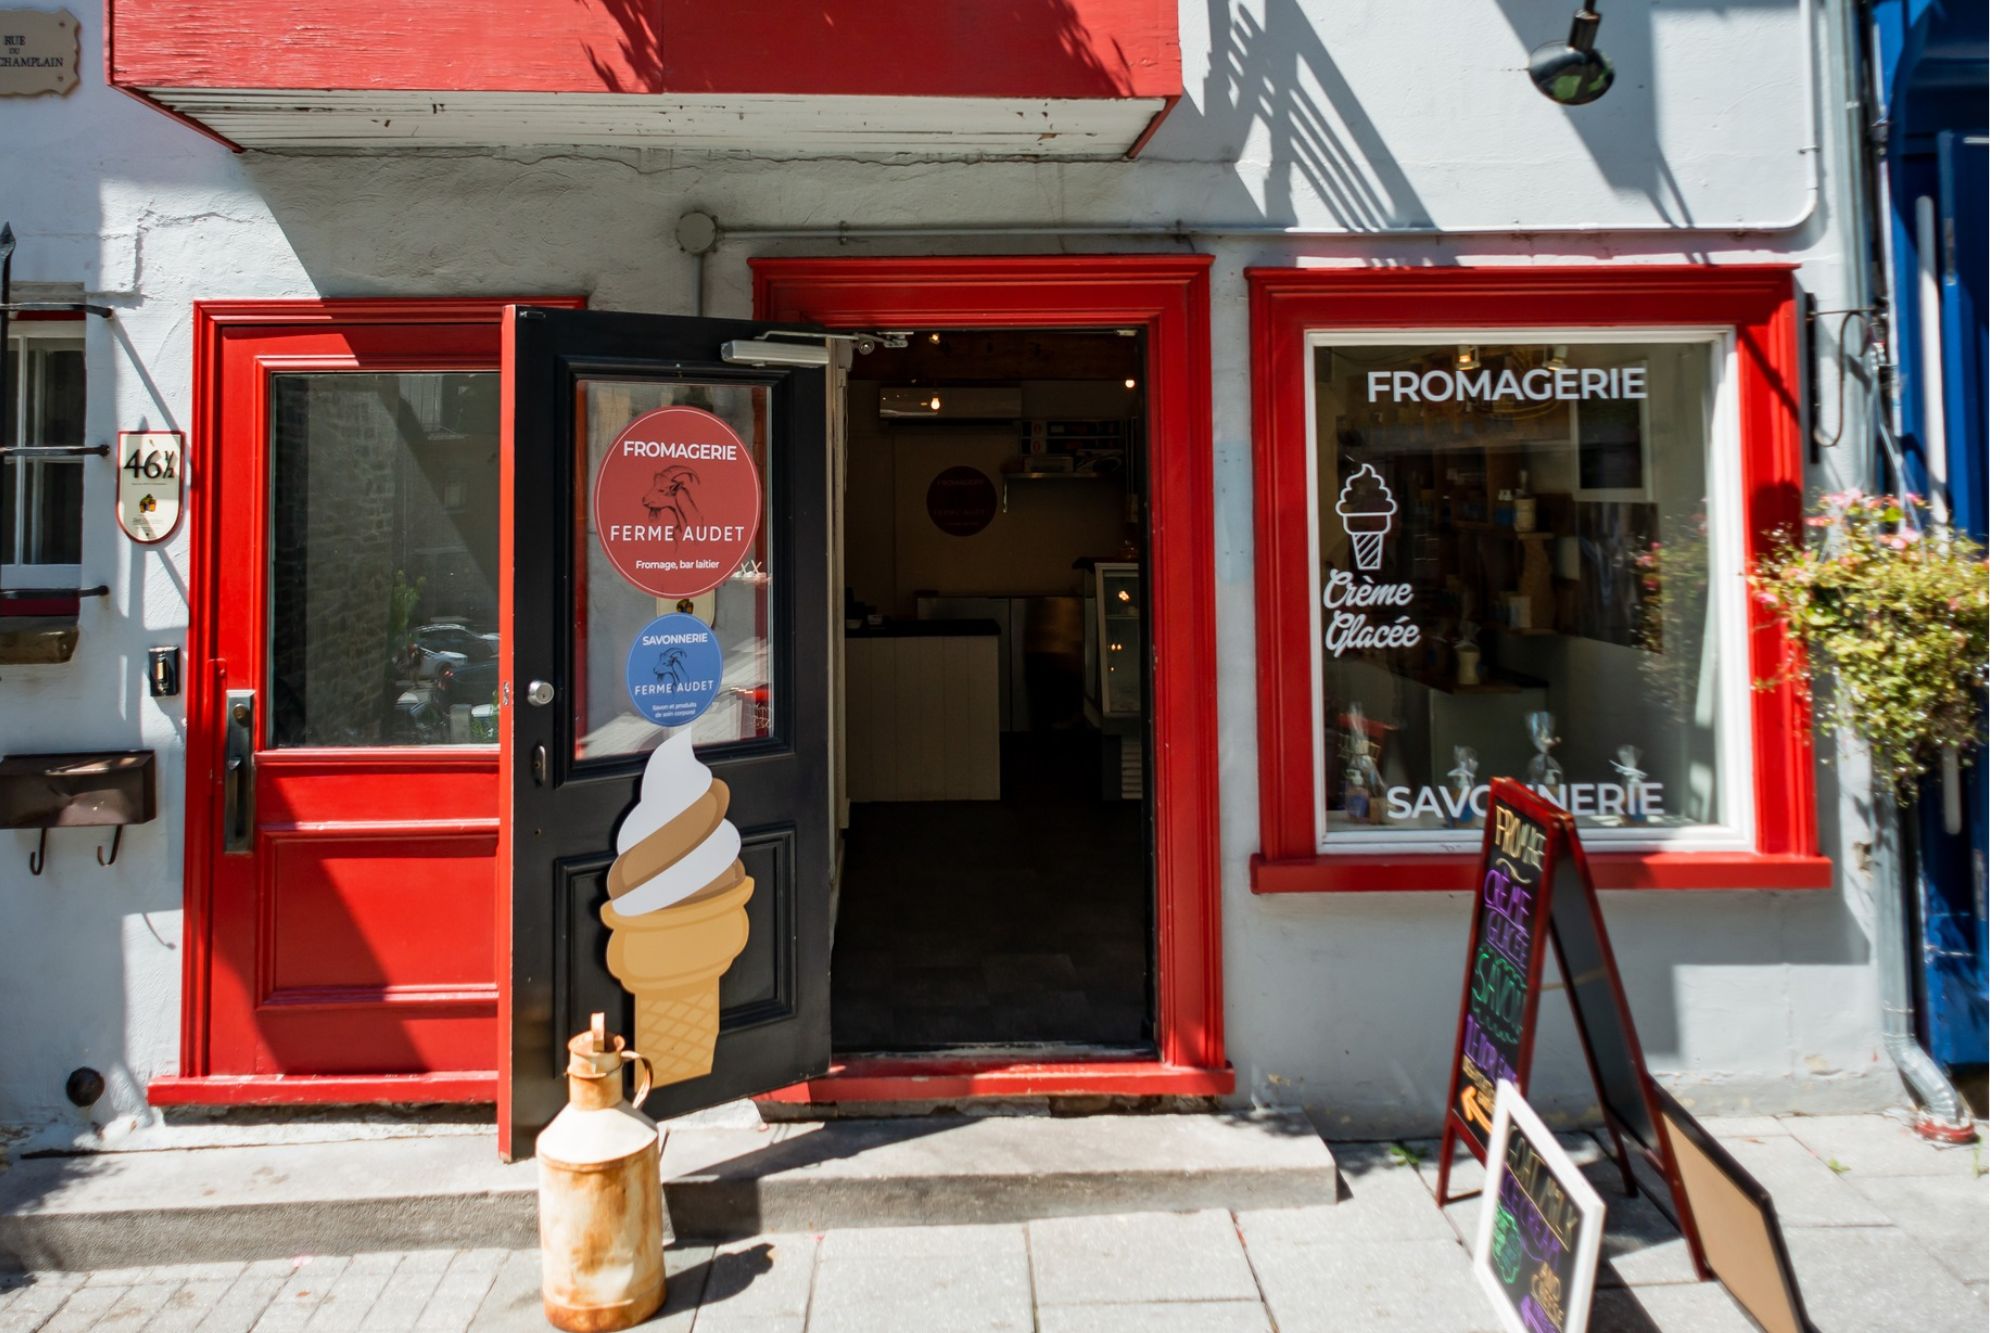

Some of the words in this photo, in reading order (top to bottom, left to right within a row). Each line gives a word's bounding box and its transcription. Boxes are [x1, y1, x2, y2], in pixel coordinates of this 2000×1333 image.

[4, 35, 26, 46] RUE
[1367, 367, 1649, 403] FROMAGERIE
[623, 441, 737, 461] FROMAGERIE
[610, 525, 674, 542] FERME
[682, 526, 745, 542] AUDET
[635, 560, 678, 571] Fromage,
[679, 560, 694, 569] bar
[695, 560, 720, 569] laitier
[1323, 569, 1414, 609] Crème
[642, 632, 709, 646] SAVONNERIE
[1325, 609, 1421, 658] Glacée
[634, 683, 672, 696] FERME
[676, 680, 714, 692] AUDET
